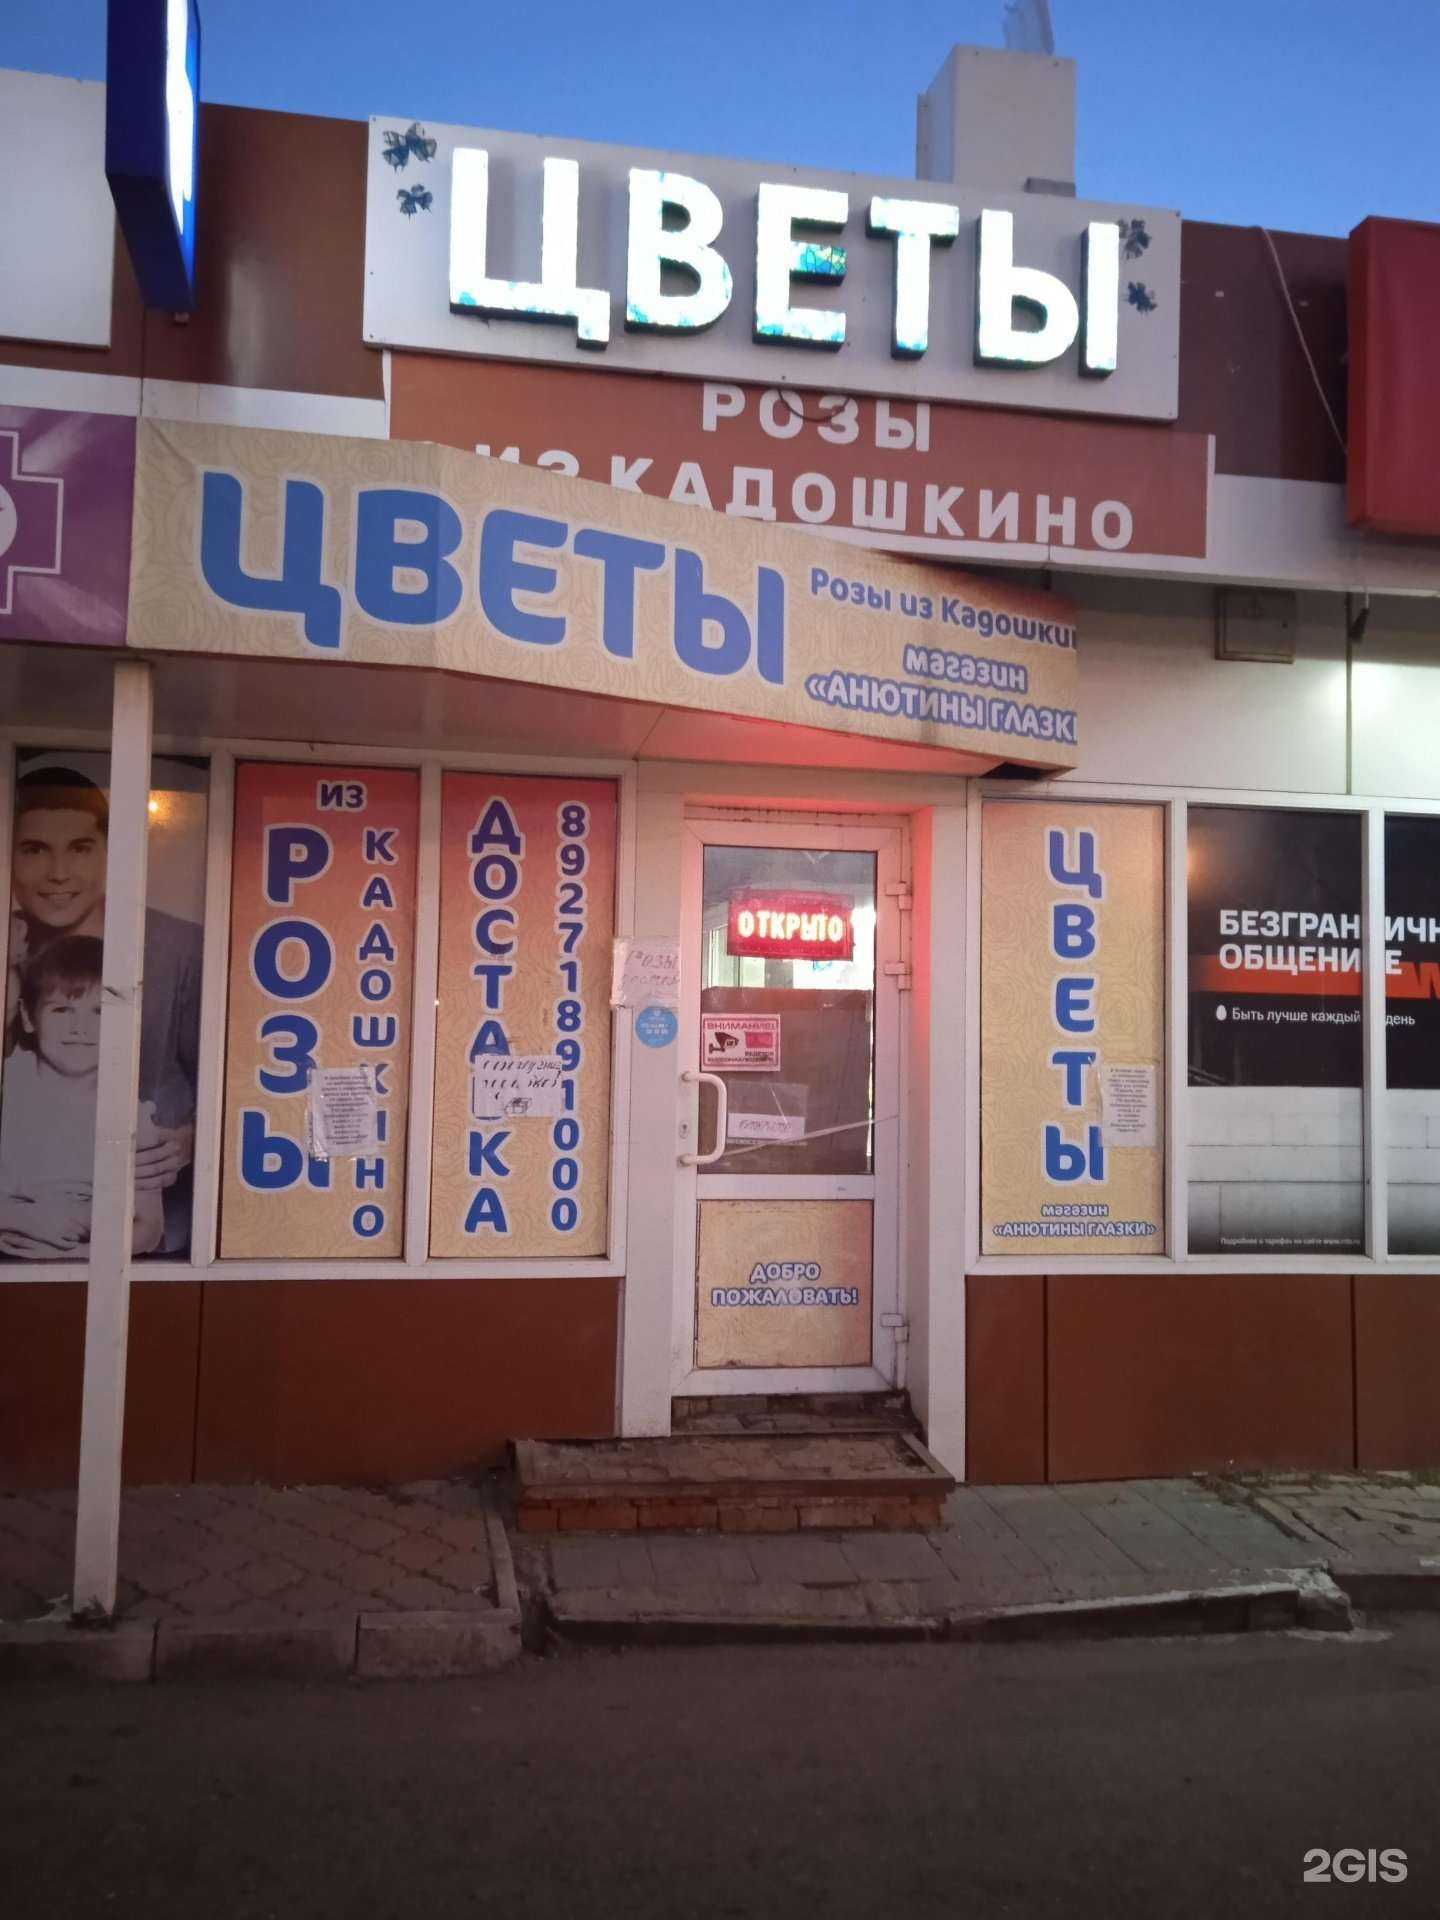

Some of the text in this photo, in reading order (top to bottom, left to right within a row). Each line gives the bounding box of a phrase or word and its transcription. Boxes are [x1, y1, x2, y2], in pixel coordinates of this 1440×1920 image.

[449, 147, 1119, 377] ЦВЕТЫ
[701, 382, 930, 452] РОЗЫ
[611, 454, 1134, 551] КАДОШКИНО
[201, 470, 785, 685] ЦВЕТЫ
[811, 568, 1076, 648] Розы из Кадошки
[905, 645, 1026, 692] магазин
[806, 672, 1077, 744] «АНЮТИНЫ ГЛАЗК
[320, 783, 364, 808] ИЗ
[738, 910, 844, 943] ОТКРЫТО
[241, 827, 331, 1189] РОЗЫ
[464, 800, 522, 1234] ДОСТАКА
[551, 805, 586, 1231] 89271891000
[1045, 830, 1104, 1182] ЦВЕТЫ
[1231, 1007, 1416, 1027] Быть лучше каждый день
[1041, 1203, 1110, 1217] магазин
[711, 1288, 859, 1305] ПОЖАЛОВАТЬ!
[750, 1262, 821, 1284] ДОБРО
